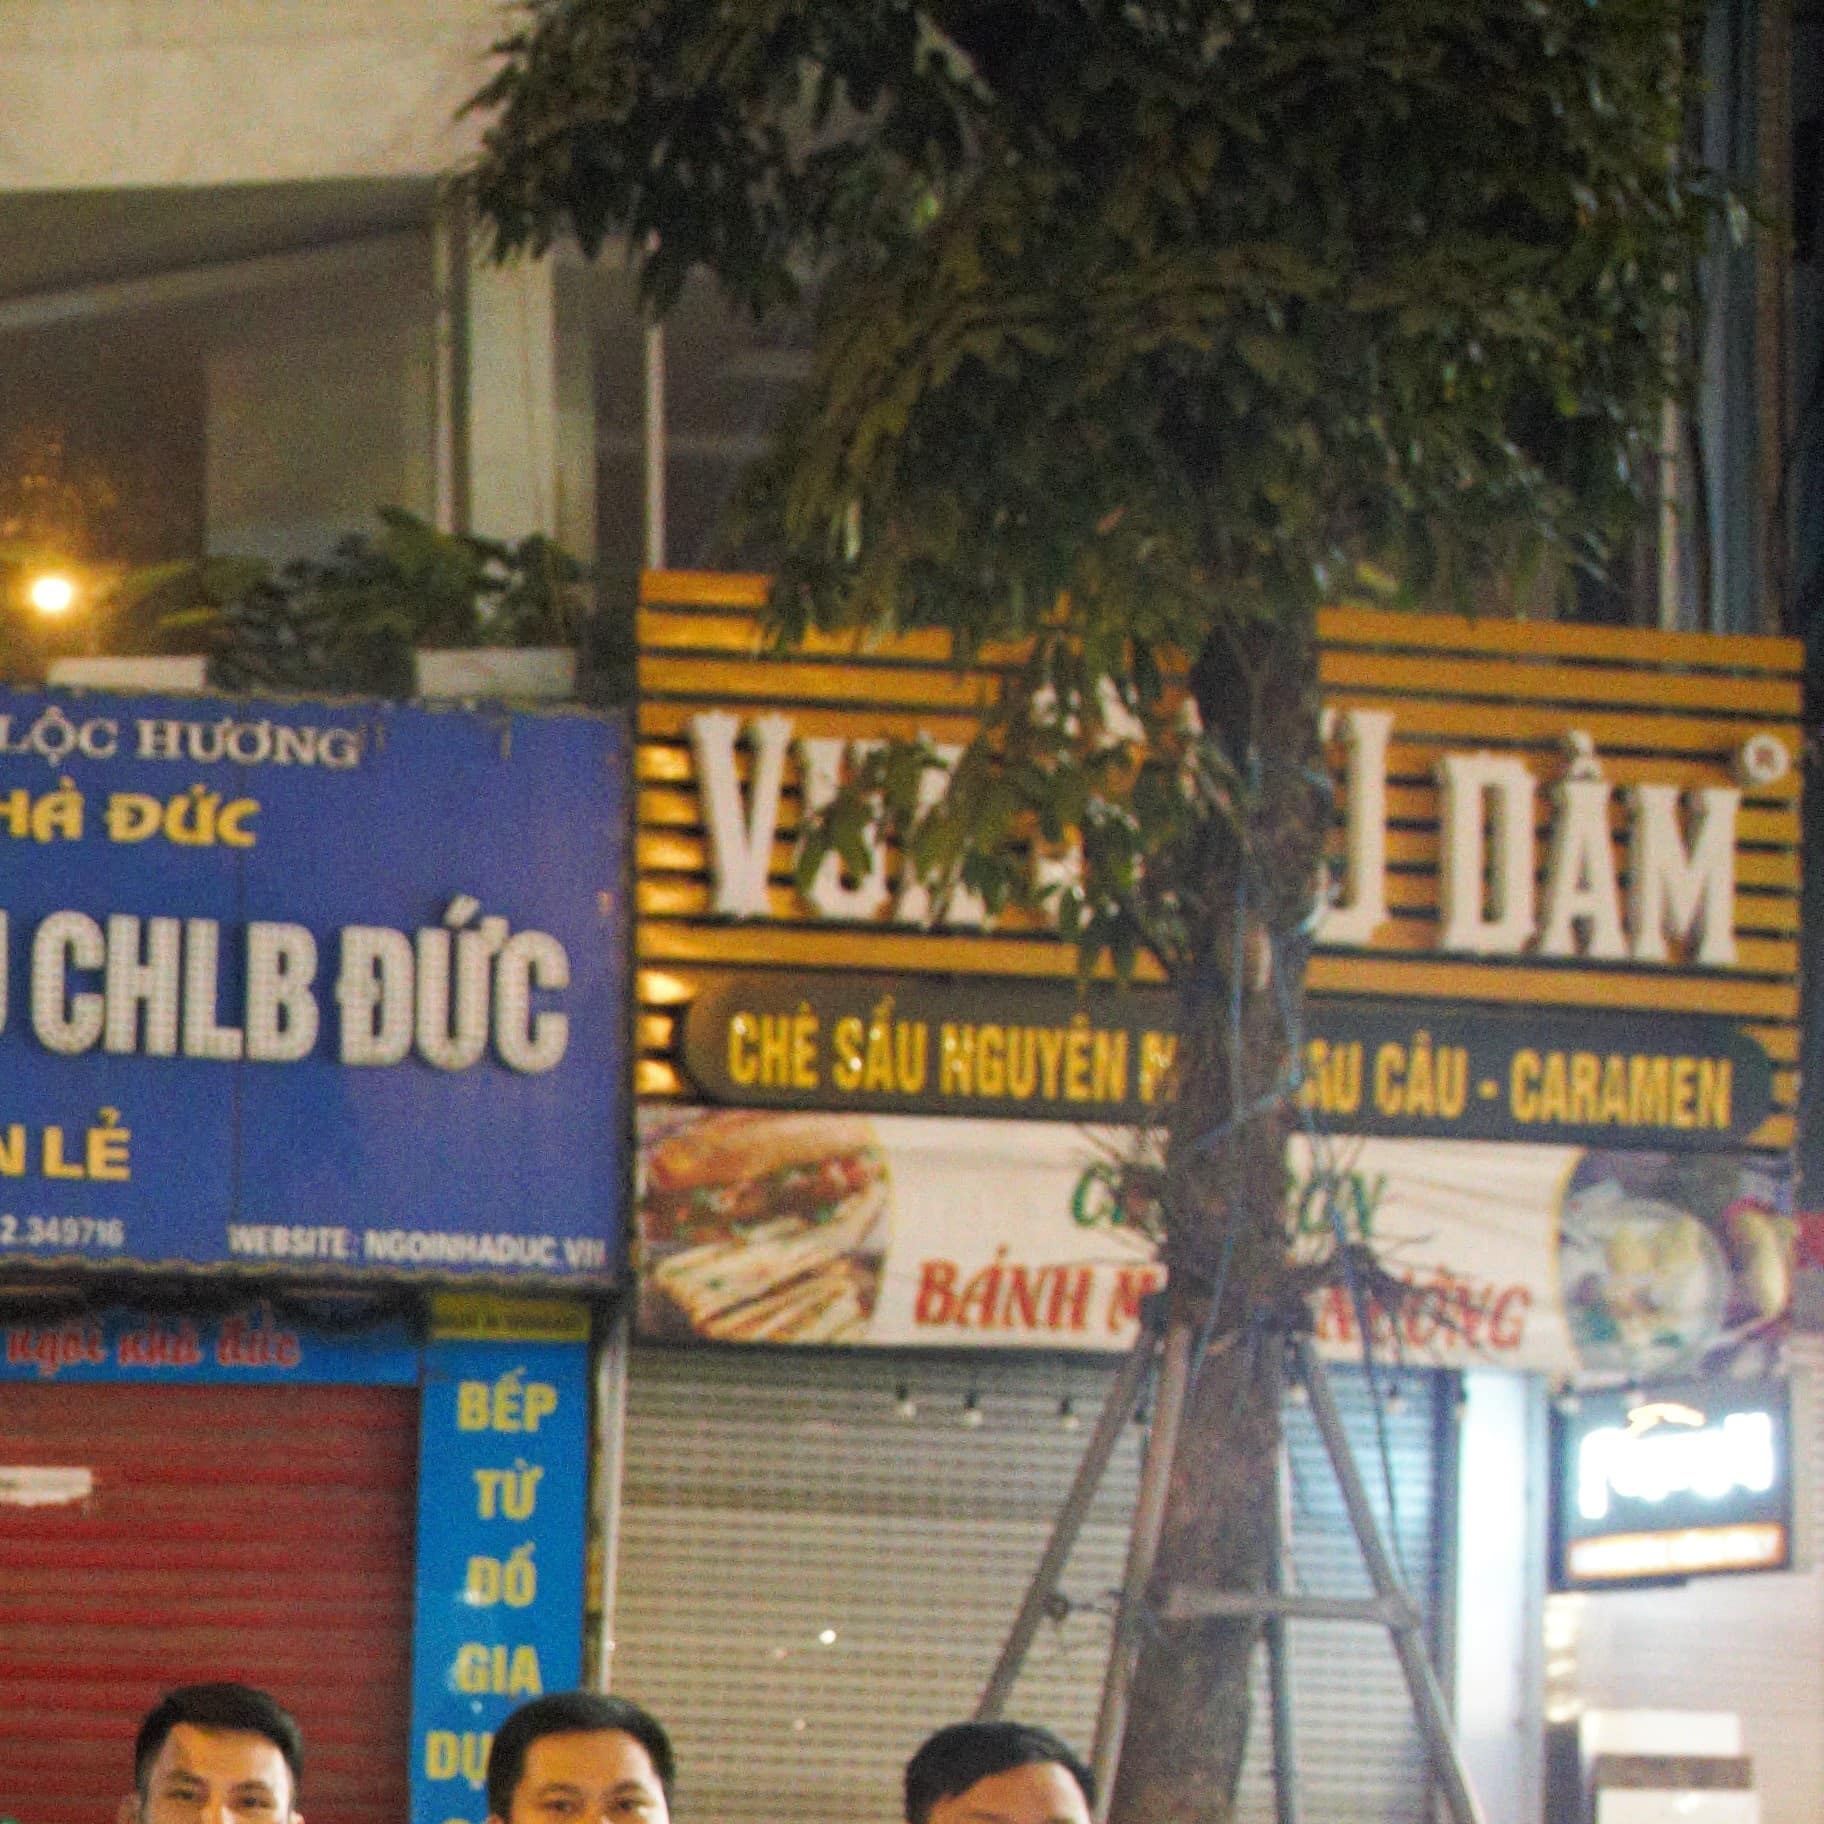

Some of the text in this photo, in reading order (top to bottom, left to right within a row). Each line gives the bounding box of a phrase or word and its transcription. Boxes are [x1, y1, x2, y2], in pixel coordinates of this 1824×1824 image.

[137, 716, 359, 768] HƯƠNG
[104, 783, 260, 848] ĐỨC
[31, 910, 320, 1064] CHLB
[335, 892, 570, 1075] ĐỨC
[1510, 1049, 1734, 1129] CARAMEN
[42, 1106, 131, 1181] LẺ
[914, 1244, 1092, 1334] BÁNH
[457, 1366, 557, 1432] BẾP
[474, 1457, 544, 1520] TỪ
[456, 1642, 543, 1696] GIA
